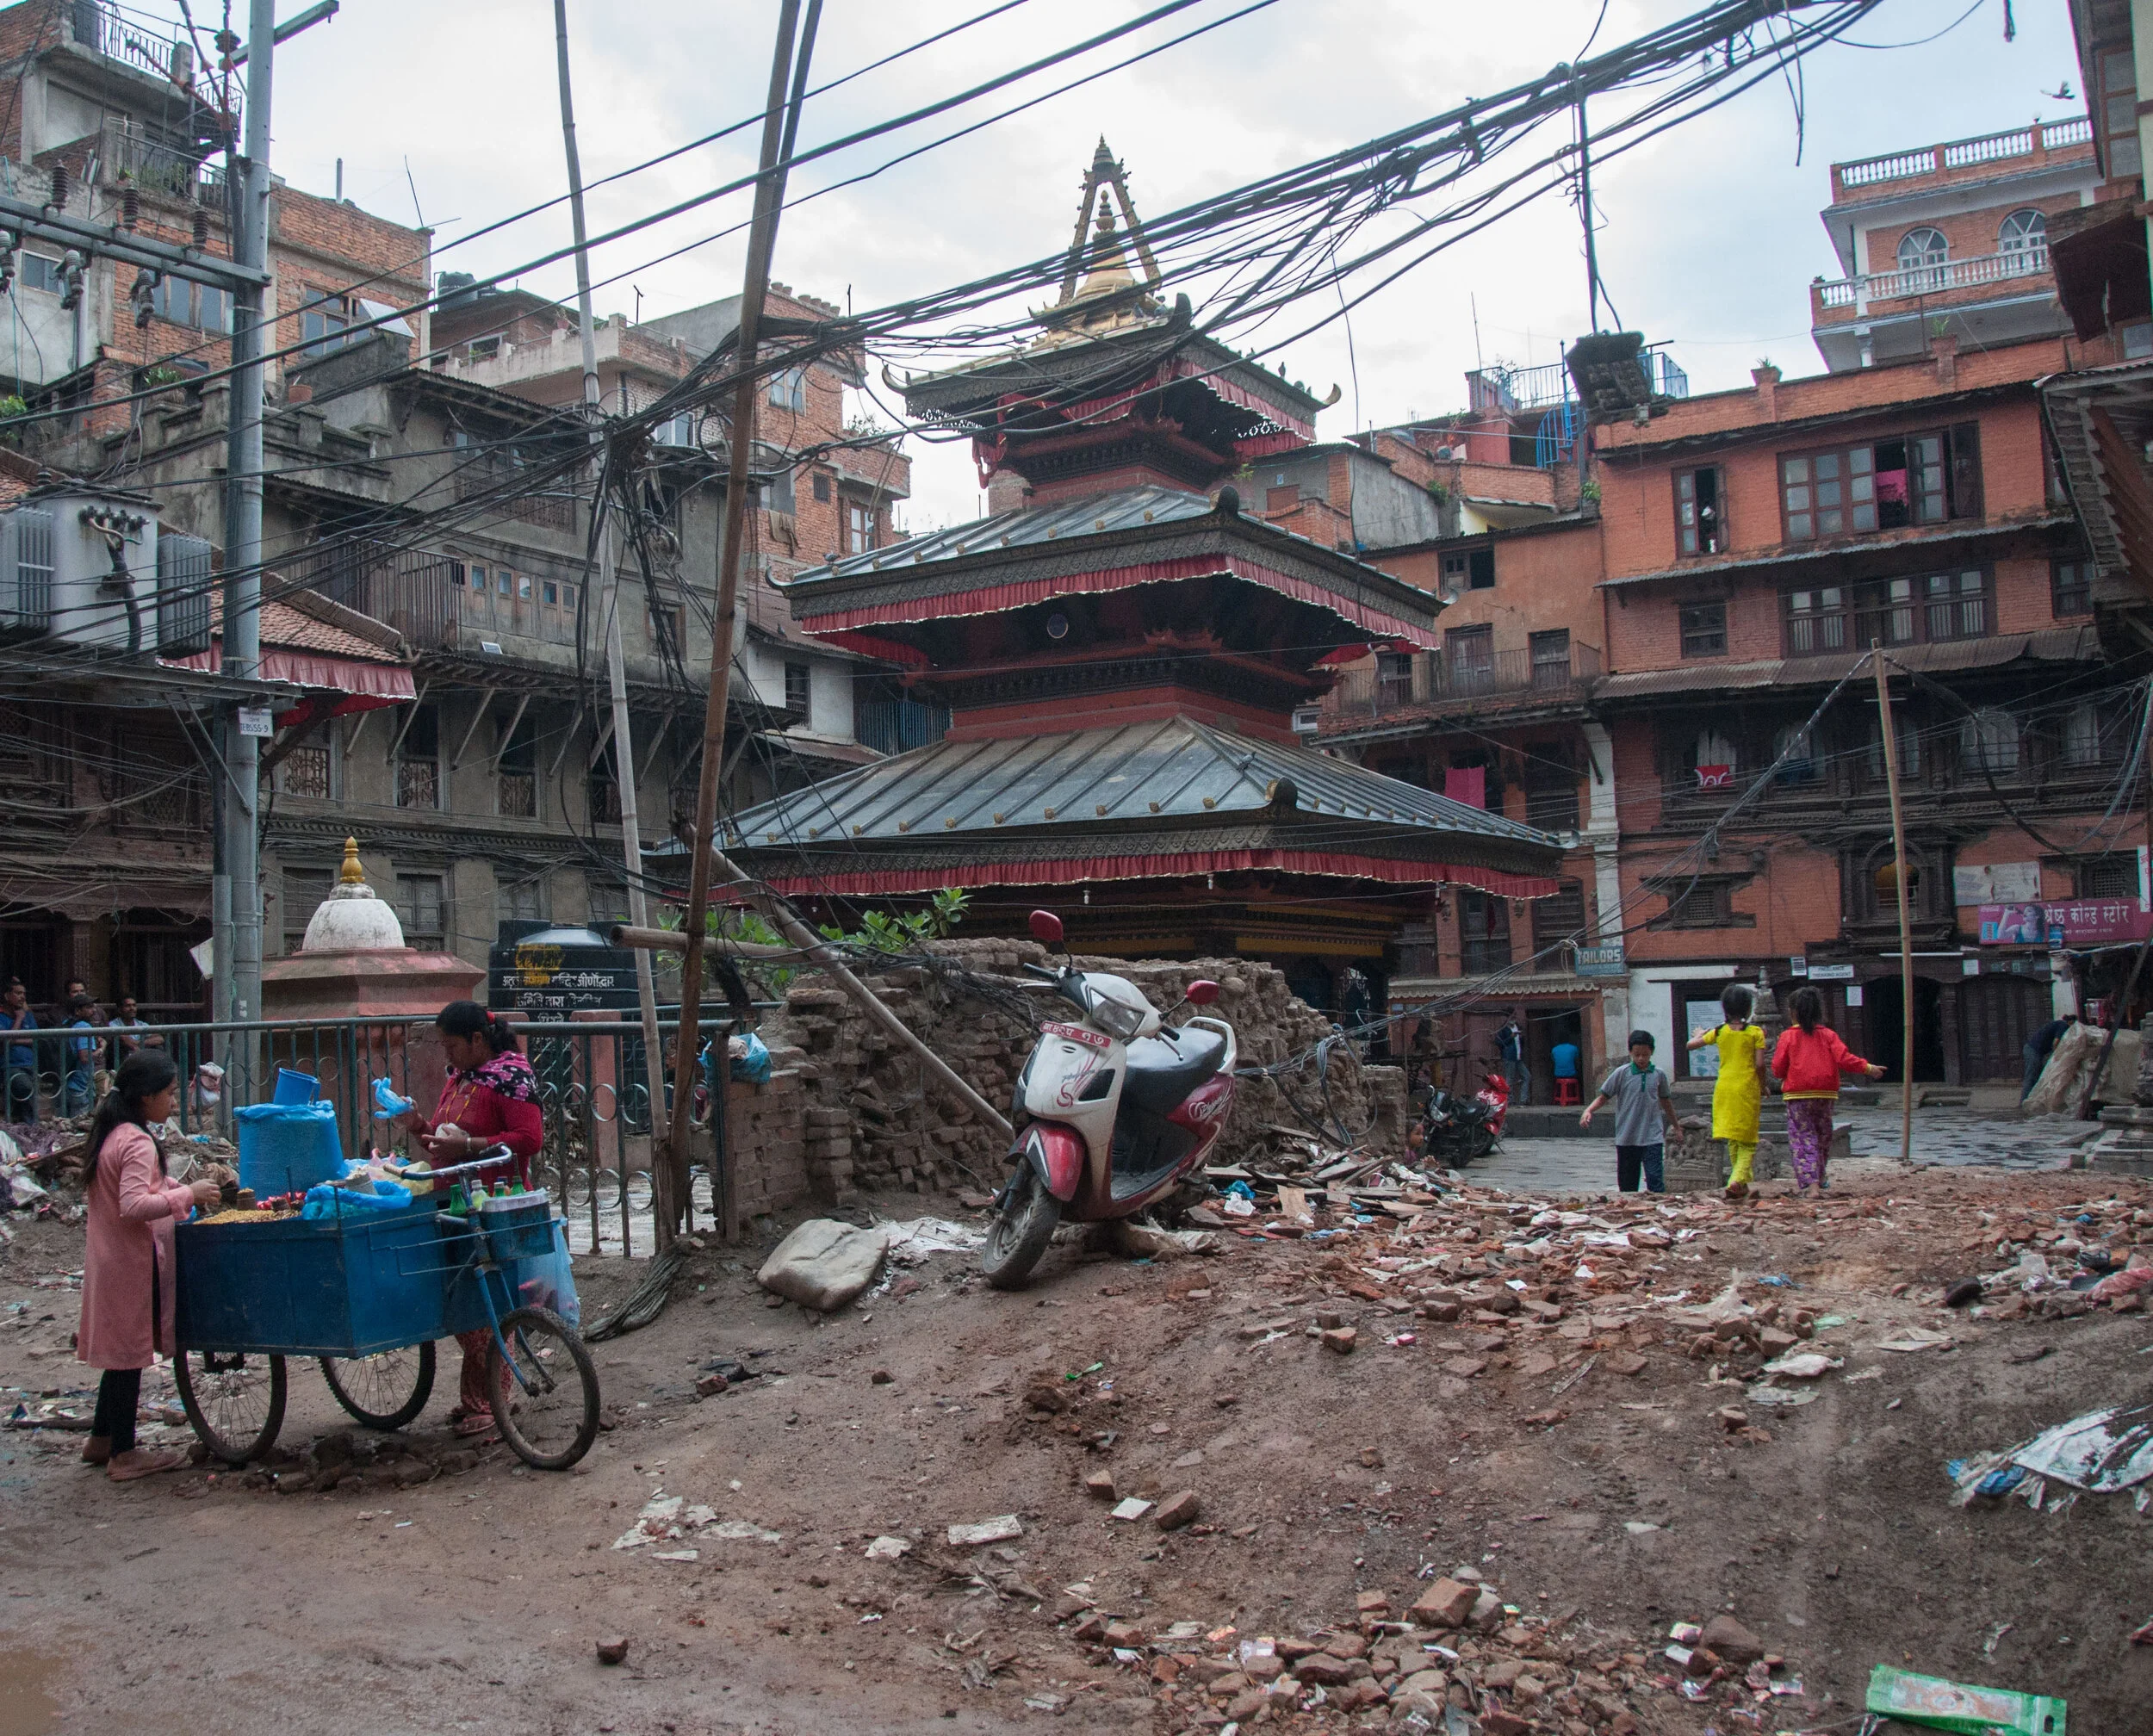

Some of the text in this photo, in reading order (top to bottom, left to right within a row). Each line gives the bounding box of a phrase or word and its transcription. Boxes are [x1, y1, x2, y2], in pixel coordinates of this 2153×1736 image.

[2069, 902, 2098, 925] कोल्ड
[2103, 901, 2129, 923] स्टोर
[1577, 948, 1621, 964] TAILORS
